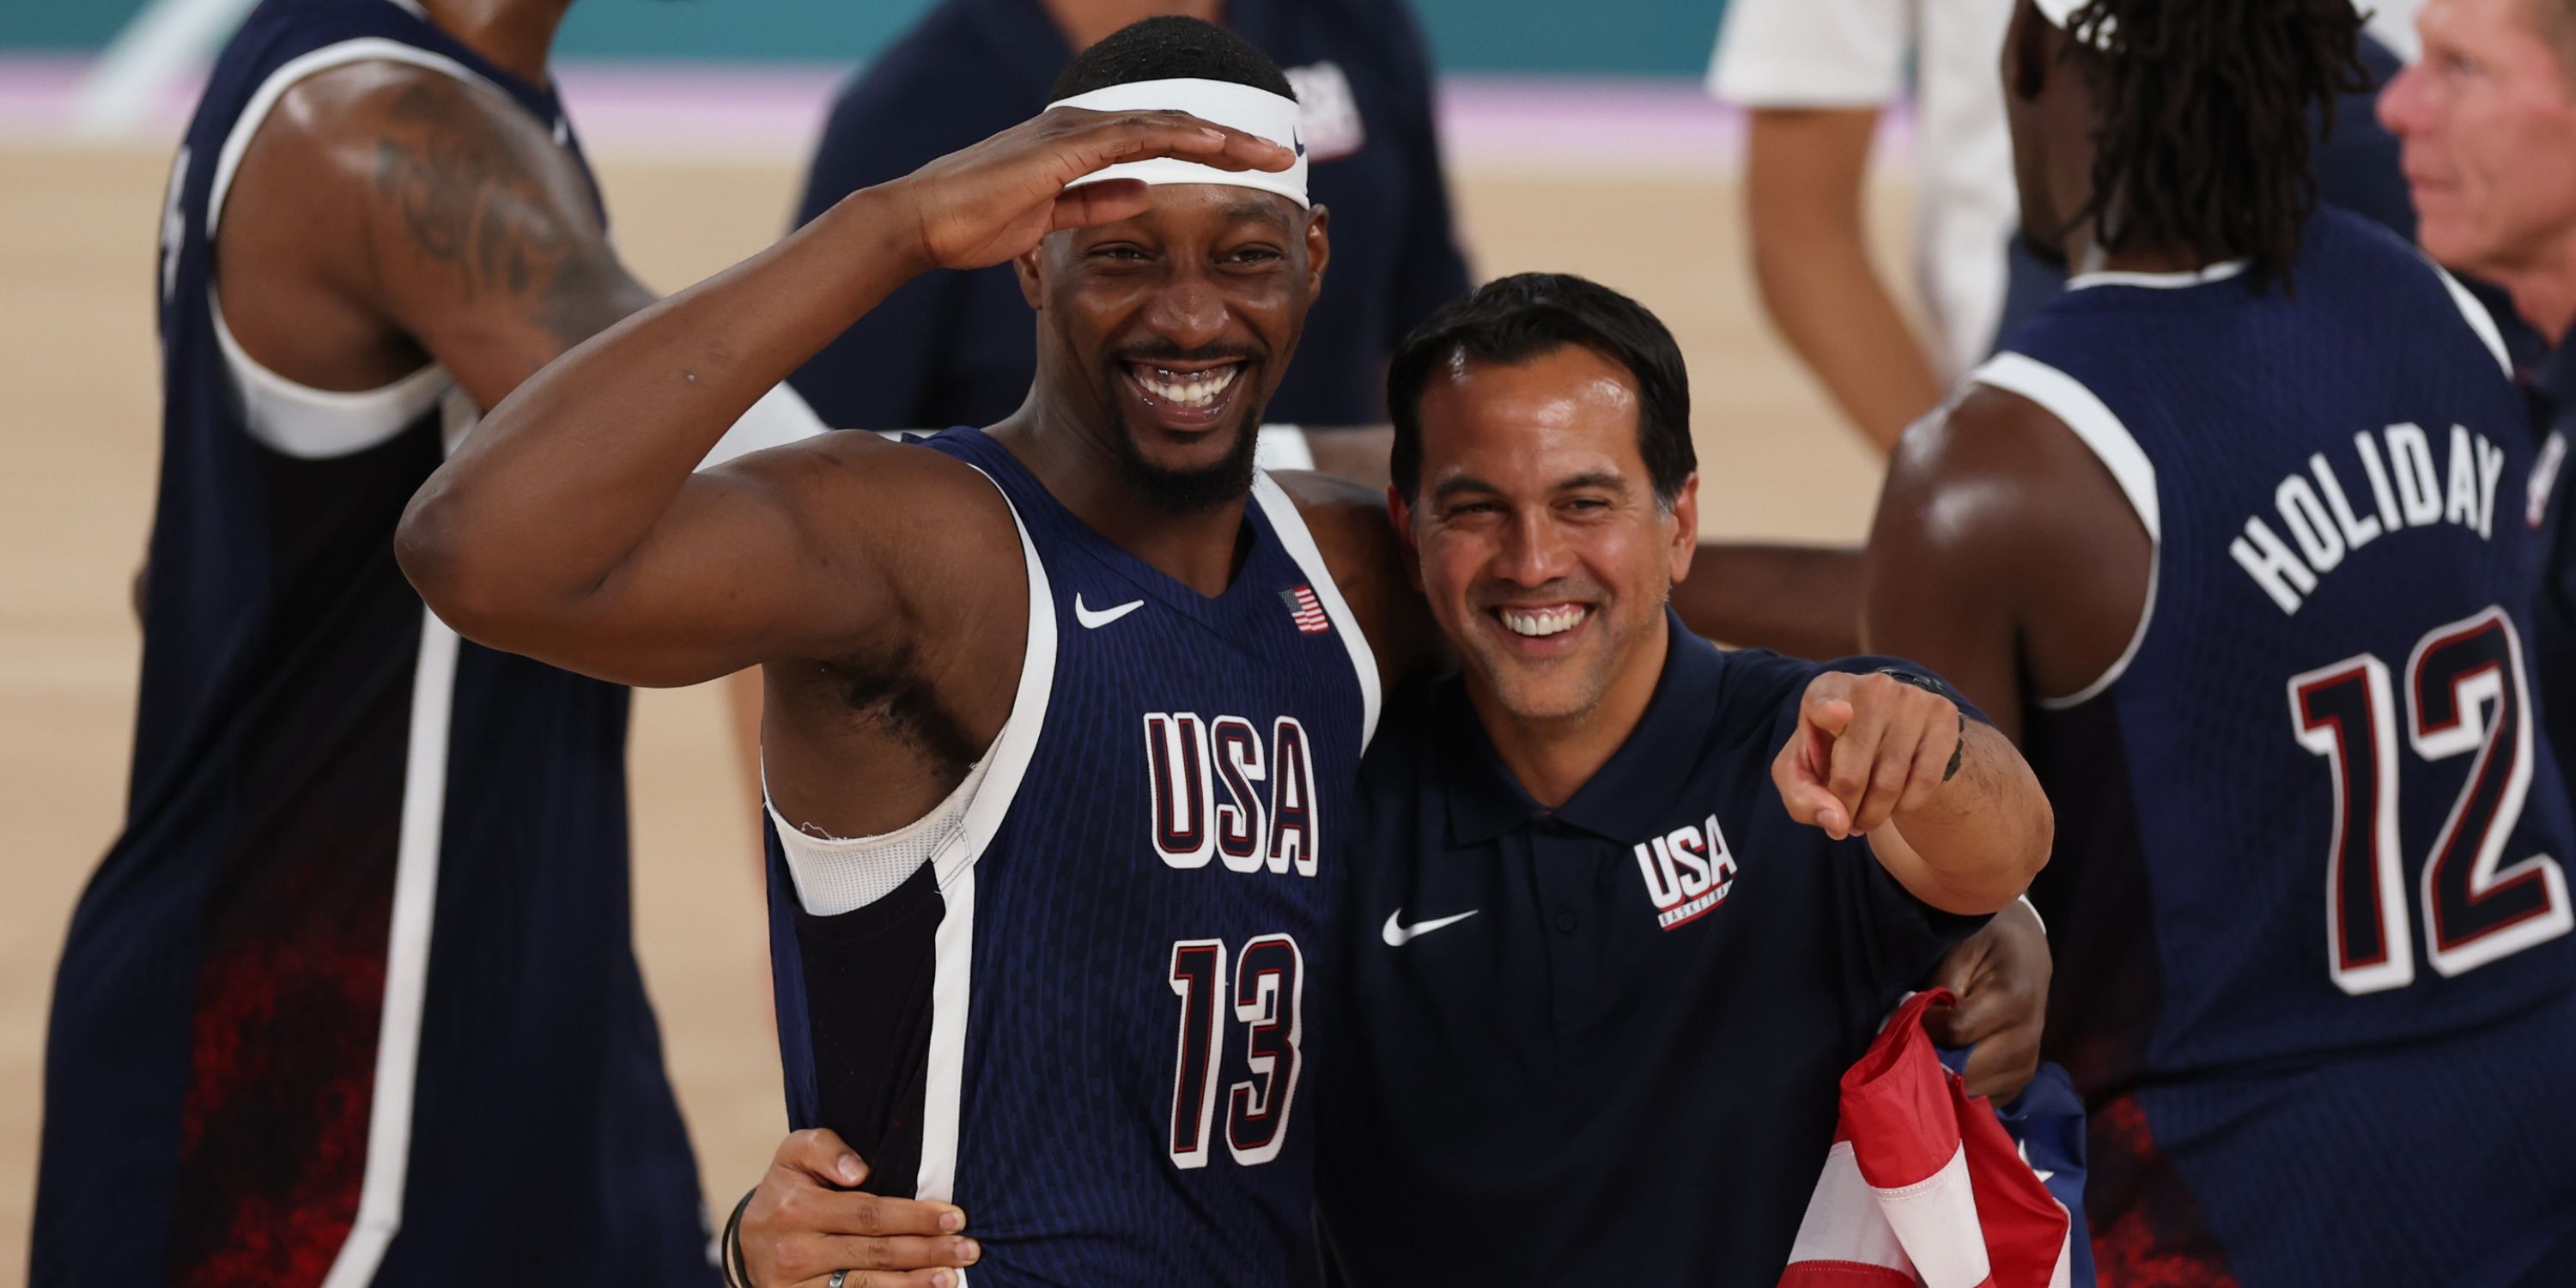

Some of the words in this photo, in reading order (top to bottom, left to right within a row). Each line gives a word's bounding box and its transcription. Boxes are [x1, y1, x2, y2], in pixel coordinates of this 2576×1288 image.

[2229, 422, 2505, 617] HOLIDAY
[1143, 712, 1320, 877] USA
[1633, 813, 1738, 910] USA
[2287, 605, 2575, 995] 12
[1169, 933, 1304, 1170] 13
